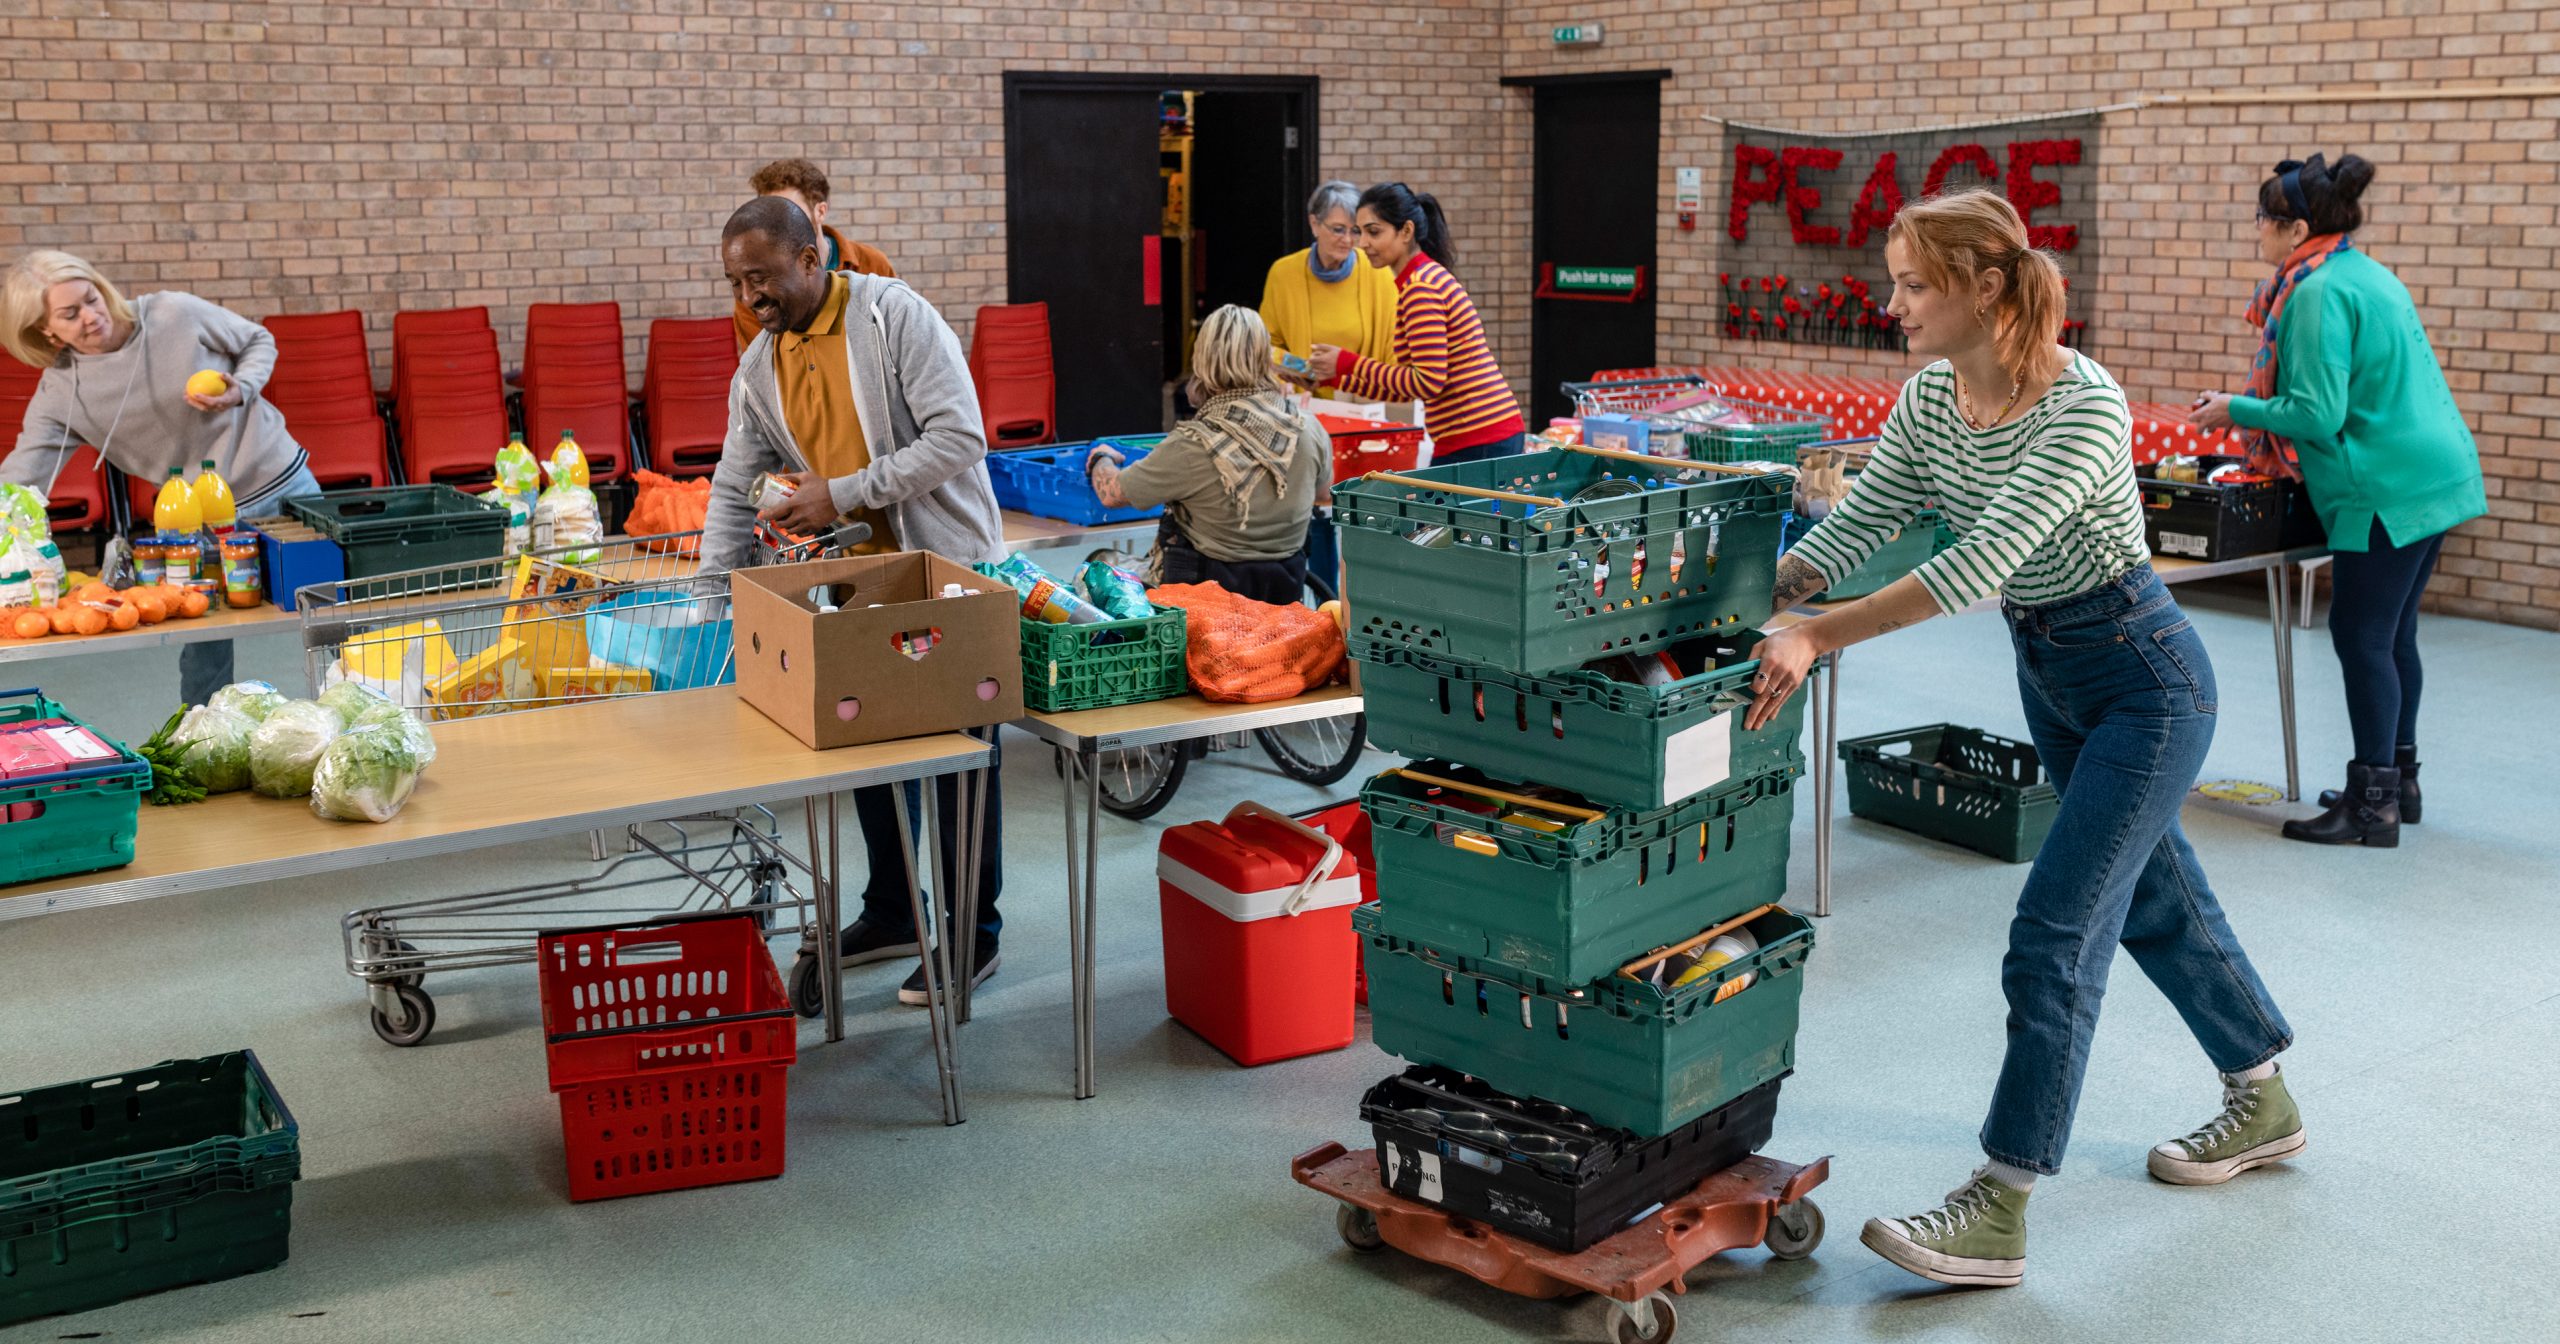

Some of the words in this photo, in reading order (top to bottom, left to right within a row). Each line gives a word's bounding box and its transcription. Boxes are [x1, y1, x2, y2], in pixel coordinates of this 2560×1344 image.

[1559, 270, 1582, 283] Push
[1583, 270, 1598, 283] bar
[1600, 272, 1610, 283] to
[1611, 274, 1634, 287] open
